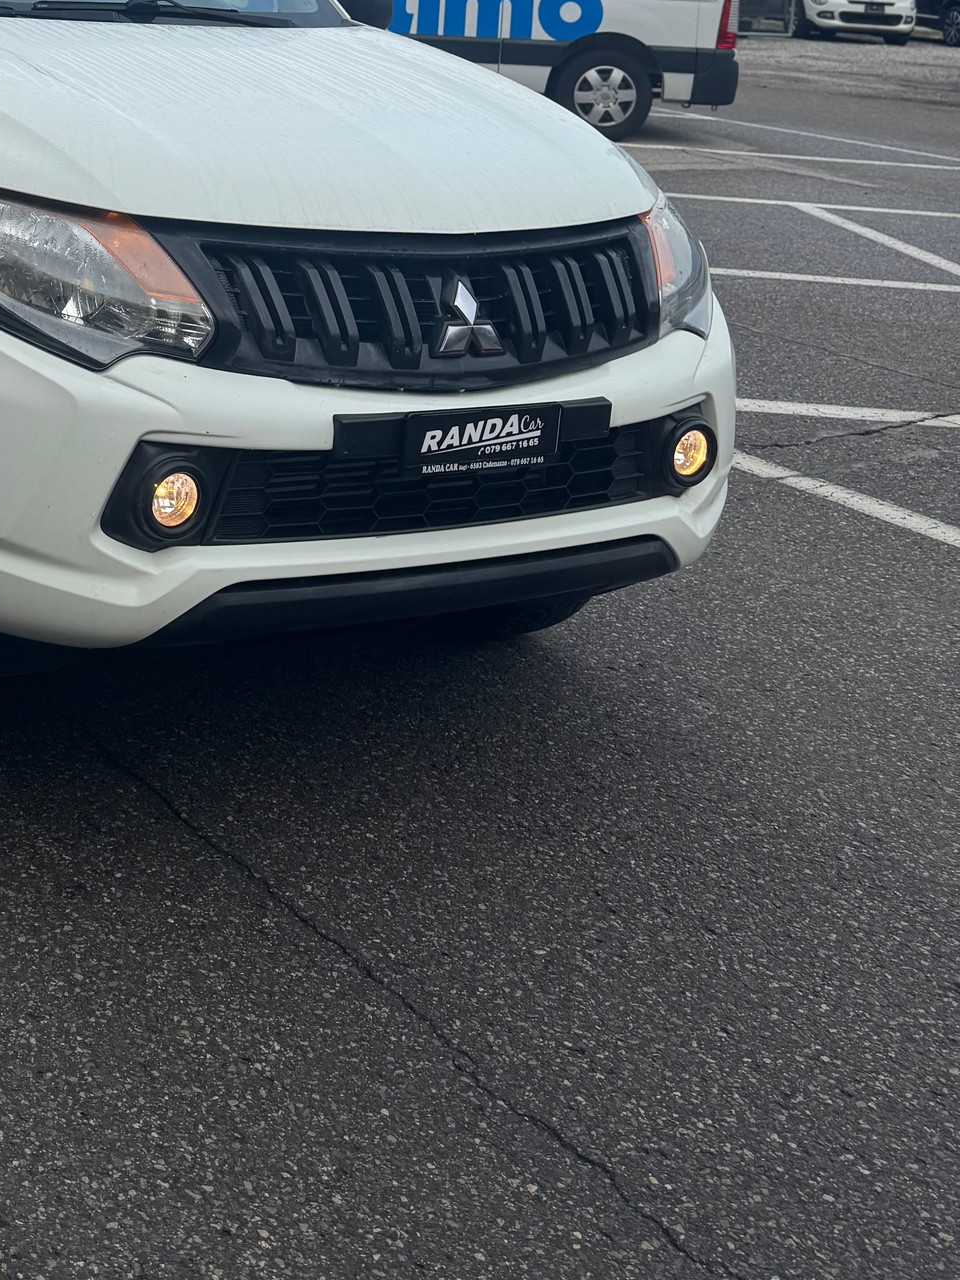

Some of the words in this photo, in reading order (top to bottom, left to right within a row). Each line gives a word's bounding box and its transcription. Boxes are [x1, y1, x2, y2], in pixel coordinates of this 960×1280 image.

[421, 414, 519, 453] RANDA
[520, 414, 544, 433] Car
[485, 444, 500, 454] 079
[501, 441, 516, 451] 667
[519, 439, 528, 448] 16
[529, 437, 539, 446] 65
[422, 464, 445, 473] RANDA
[445, 463, 459, 472] CAR
[510, 458, 520, 466] 079
